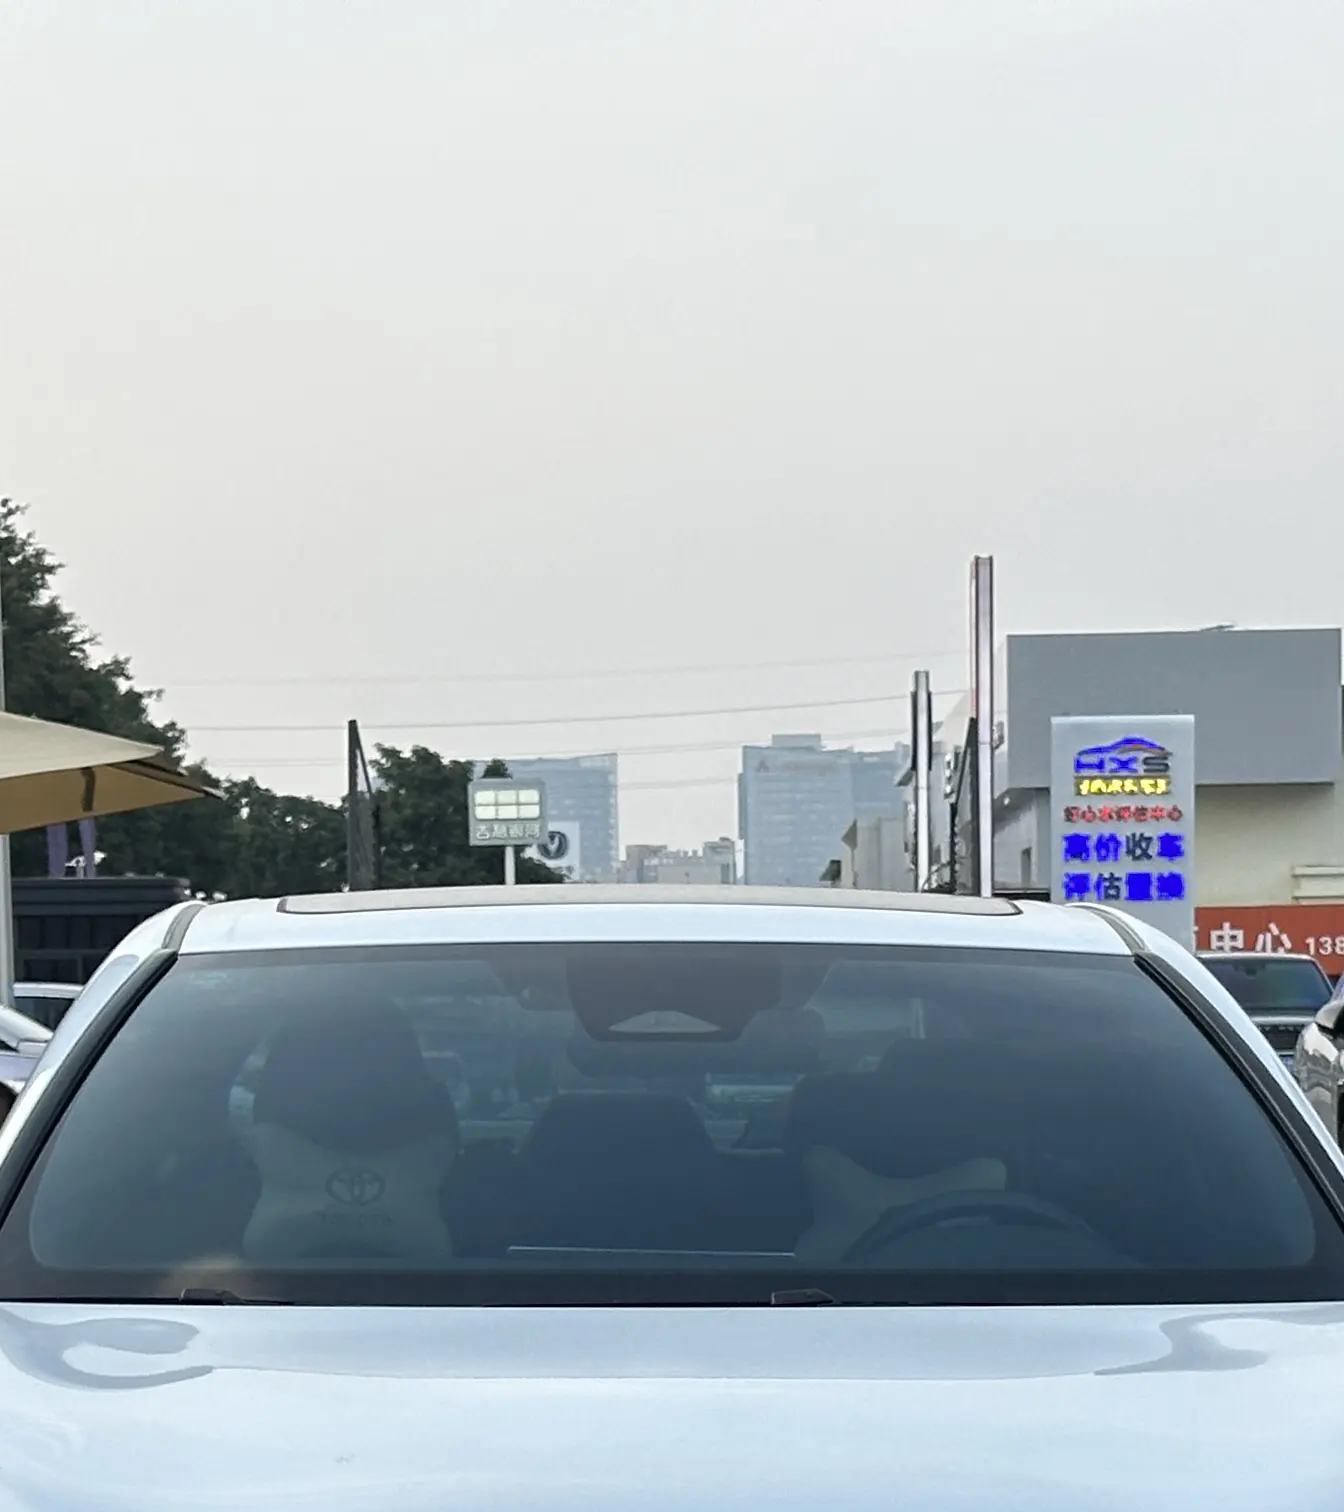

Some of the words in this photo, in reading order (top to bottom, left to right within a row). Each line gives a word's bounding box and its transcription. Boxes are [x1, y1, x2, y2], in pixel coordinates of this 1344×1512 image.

[1062, 831, 1185, 862] 高价收车
[1193, 921, 1292, 954] 中心
